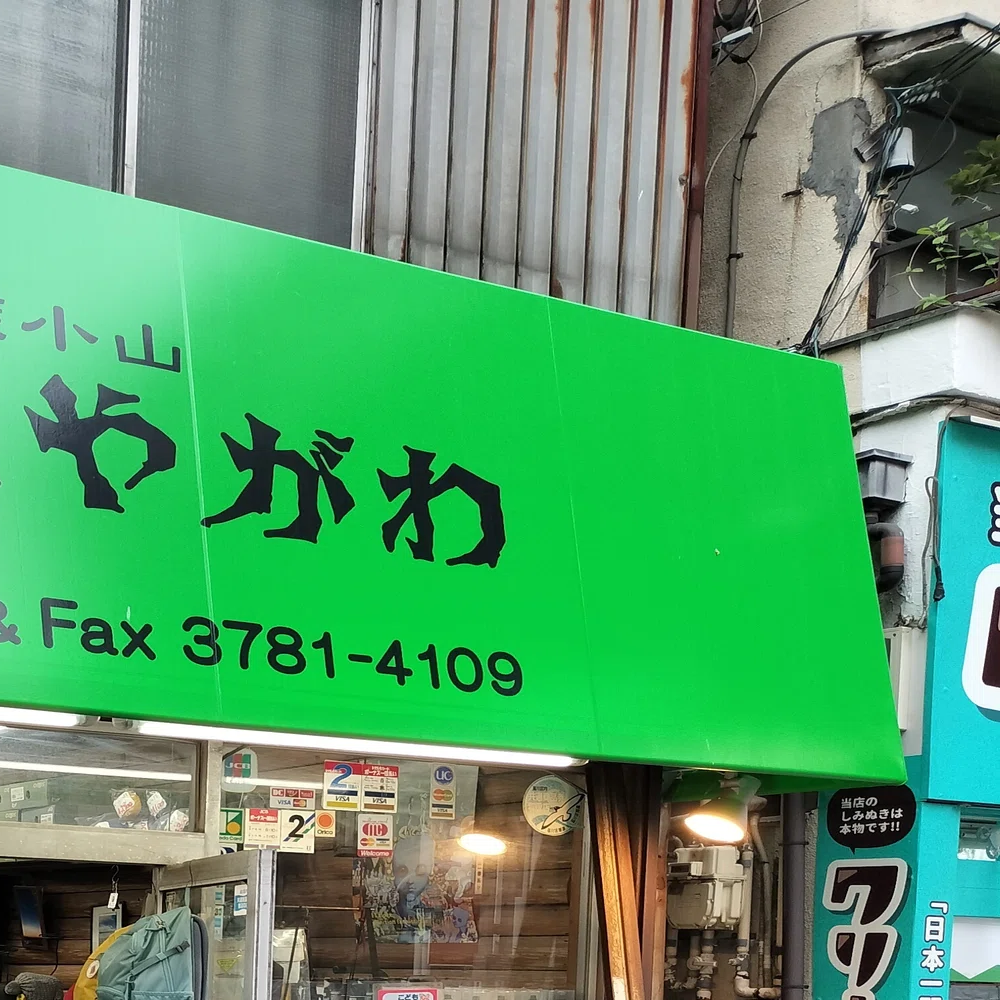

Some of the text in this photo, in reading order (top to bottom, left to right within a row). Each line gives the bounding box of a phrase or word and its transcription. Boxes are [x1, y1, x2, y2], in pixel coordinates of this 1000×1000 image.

[40, 597, 157, 661] Fax
[182, 616, 523, 697] 3781-4109
[436, 771, 453, 781] UC
[841, 796, 878, 809] 当店の
[841, 808, 904, 821] しみぬきは
[288, 814, 305, 838] 2
[398, 993, 418, 1000] こども
